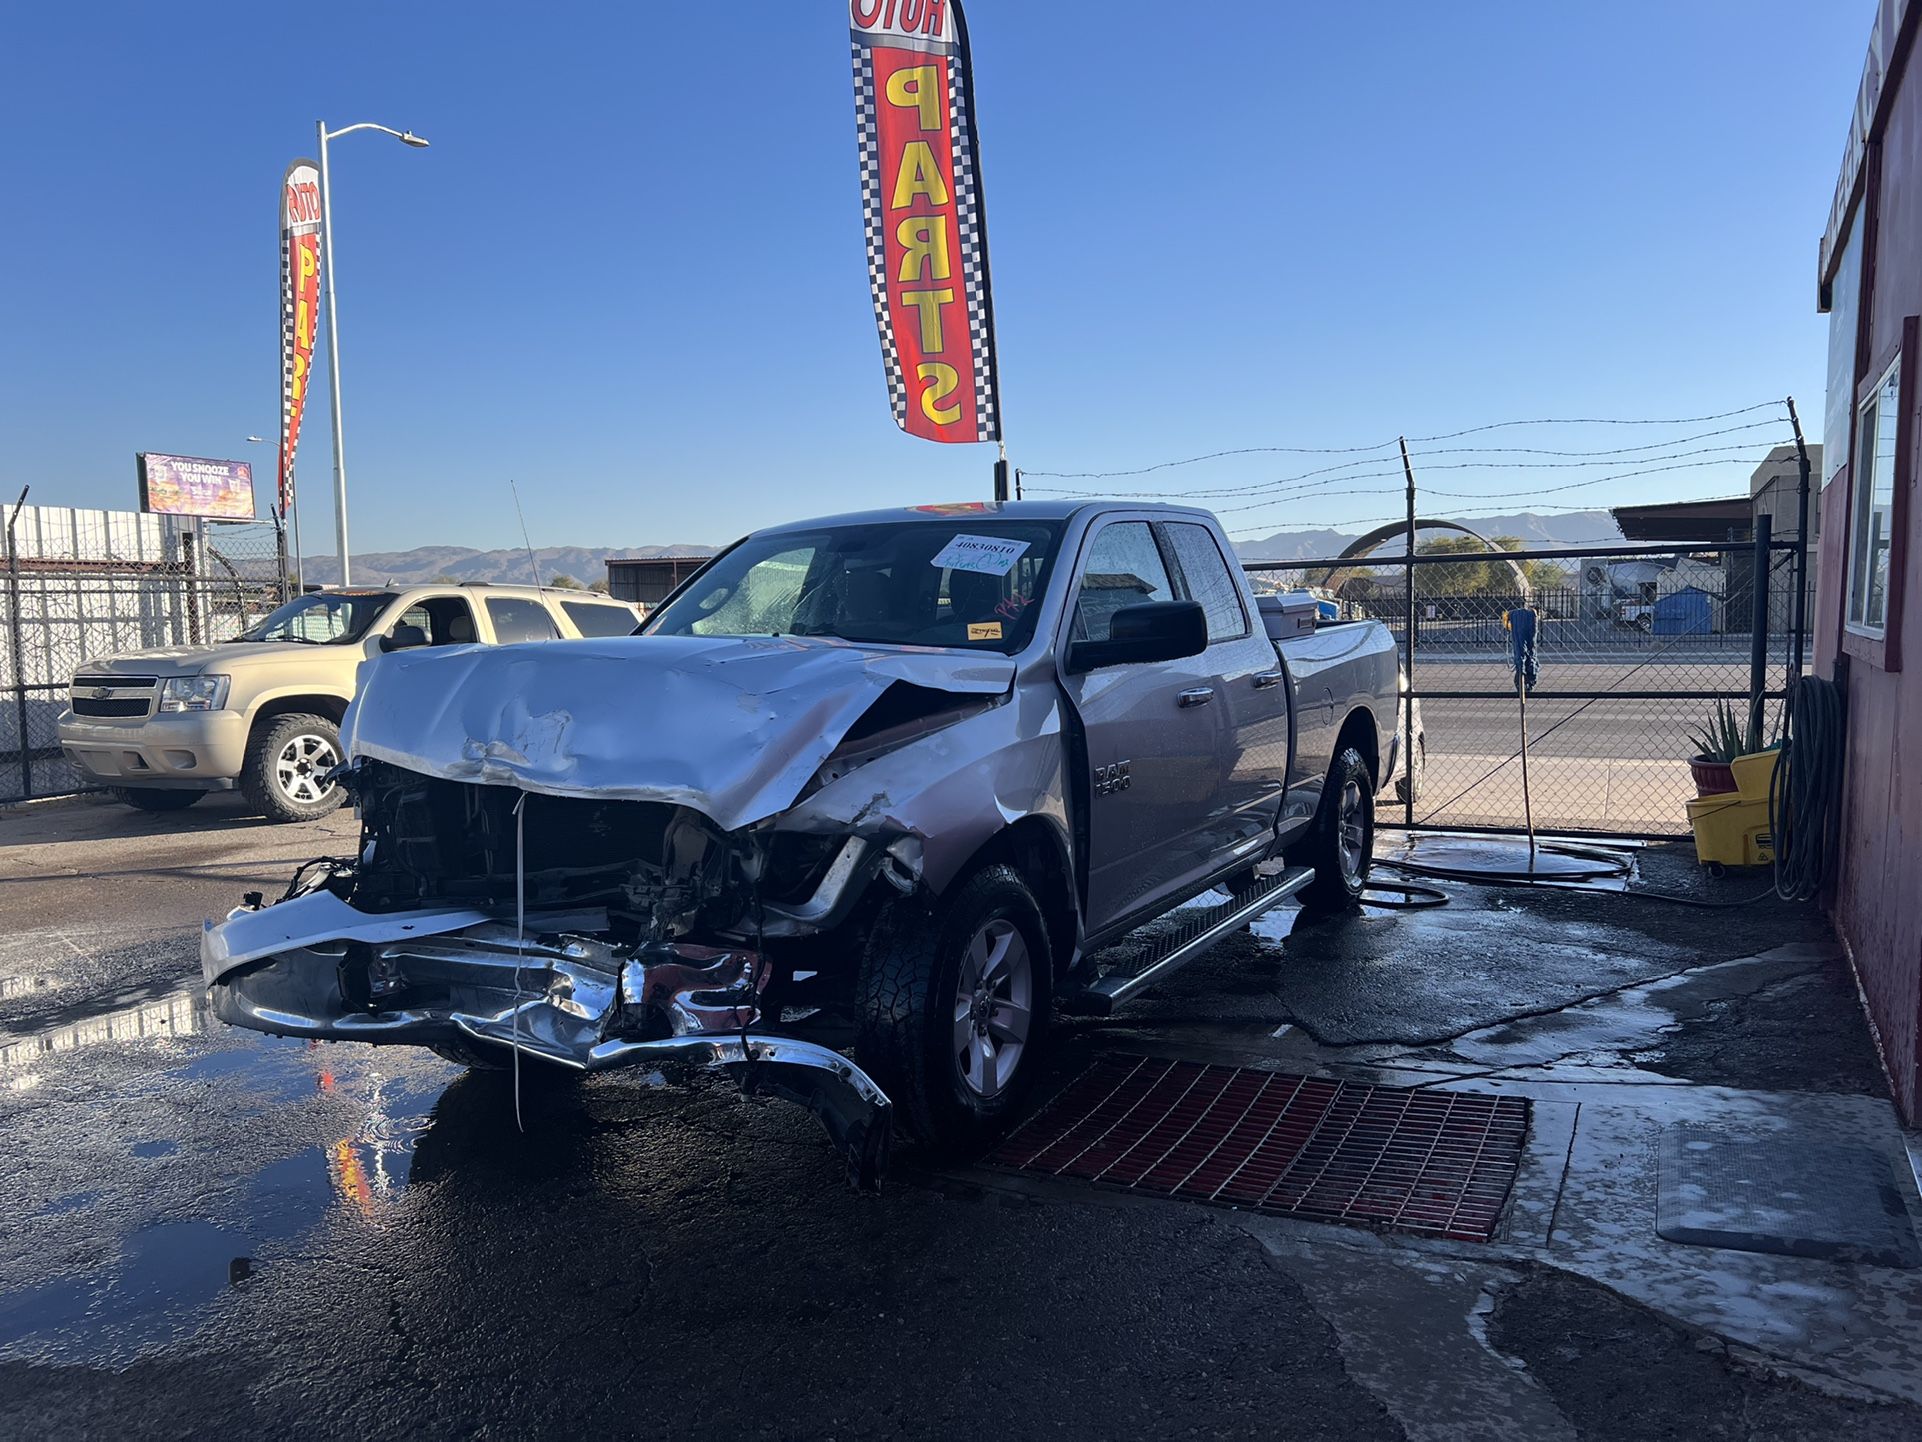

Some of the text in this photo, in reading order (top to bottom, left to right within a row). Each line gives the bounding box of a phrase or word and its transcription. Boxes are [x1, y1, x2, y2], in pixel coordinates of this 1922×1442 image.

[287, 181, 320, 222] AUTO
[171, 462, 230, 475] YOU SNOOZE
[181, 473, 222, 485] YOU WIN
[956, 541, 1016, 554] 40830810
